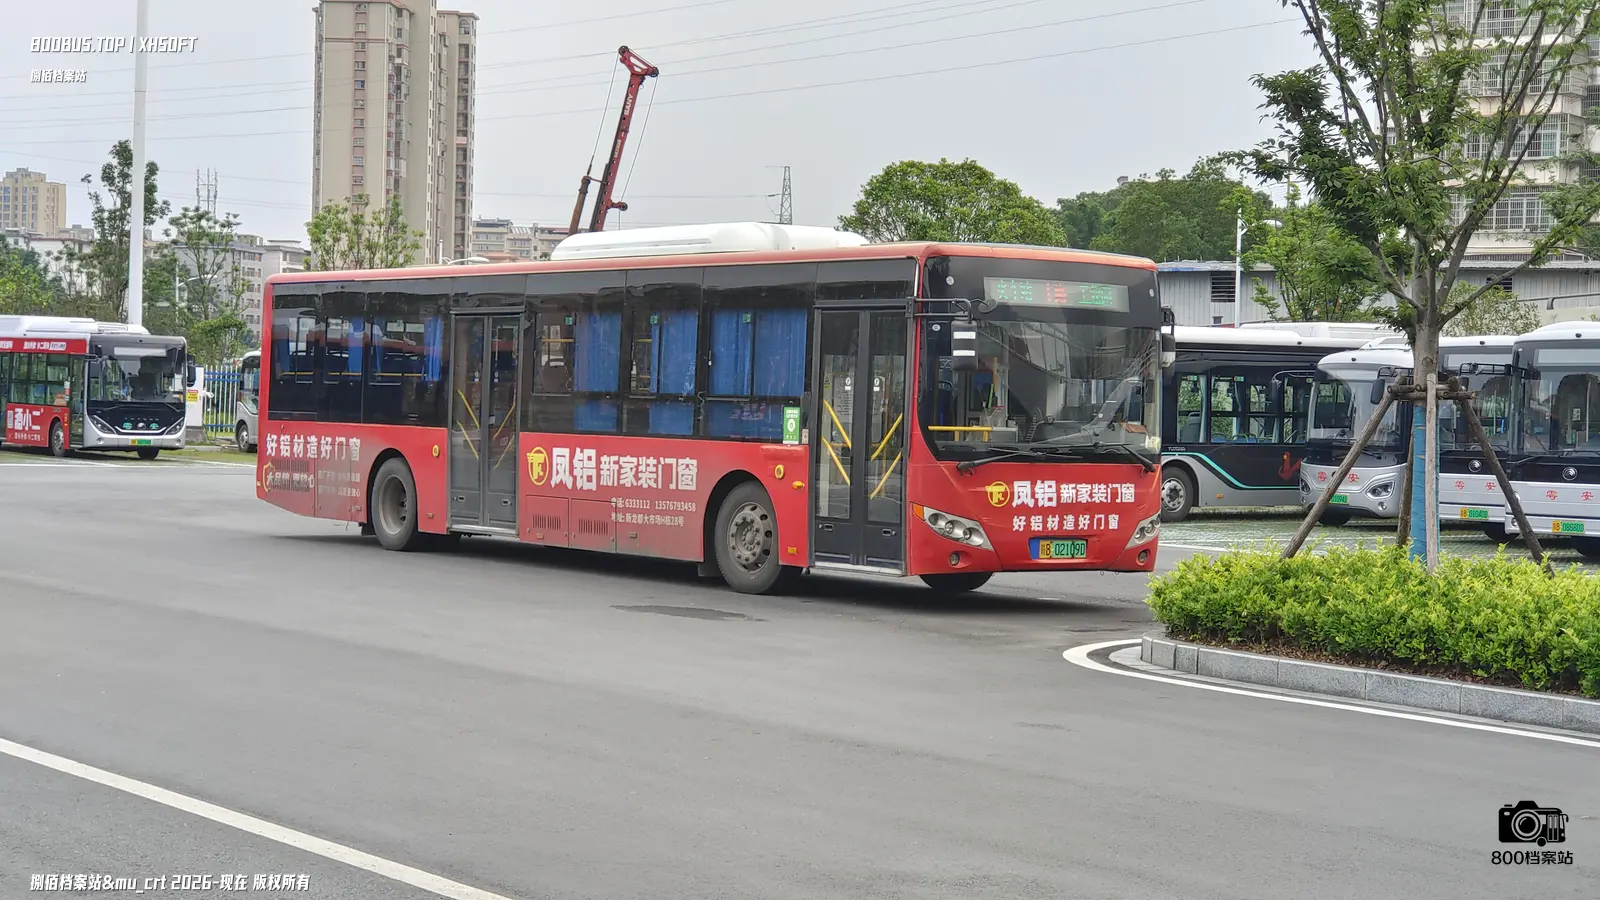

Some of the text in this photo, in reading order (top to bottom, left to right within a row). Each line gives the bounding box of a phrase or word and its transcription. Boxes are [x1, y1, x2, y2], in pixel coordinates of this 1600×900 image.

[265, 433, 360, 461] 好铝材造好门窗
[550, 447, 698, 491] 凤铝 新家装门窗
[654, 500, 697, 512] 13576793458
[1011, 480, 1135, 508] 凤铝 新家装门窗
[1012, 514, 1119, 531] 好铝材造好门窗
